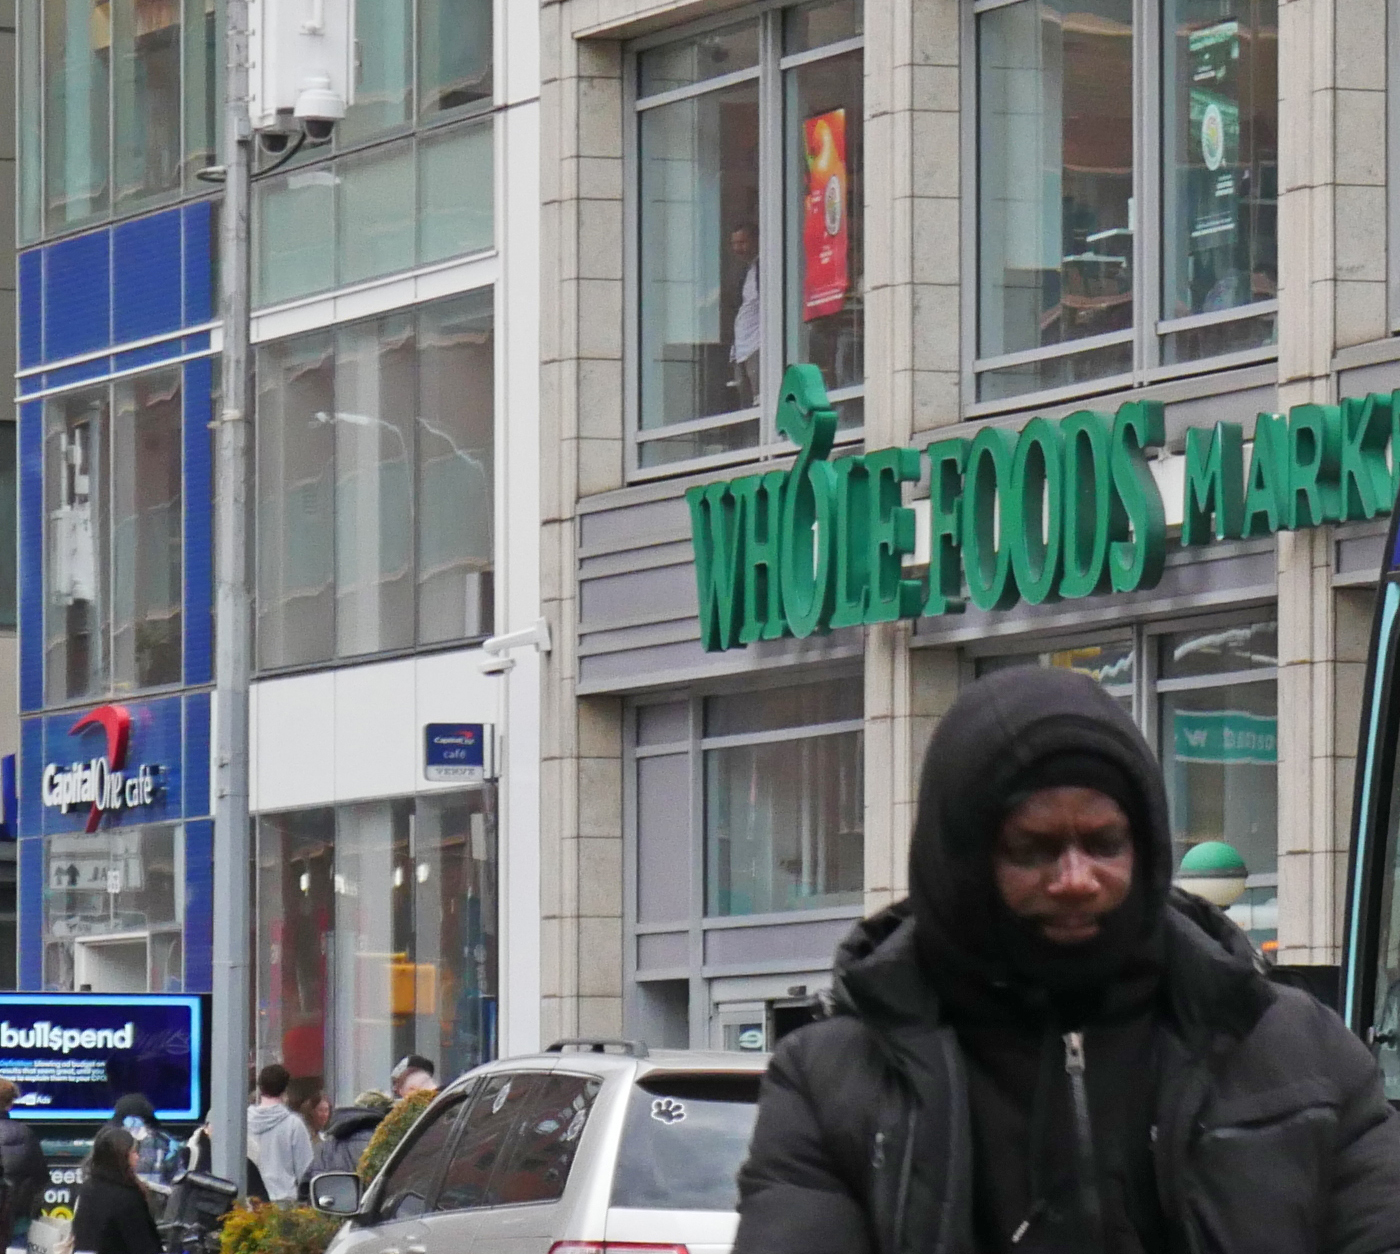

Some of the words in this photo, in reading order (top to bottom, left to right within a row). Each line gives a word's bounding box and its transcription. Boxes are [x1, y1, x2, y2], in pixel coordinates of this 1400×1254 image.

[684, 412, 923, 653] WHOLE
[923, 400, 1166, 618] FOODS
[124, 763, 154, 808] café
[49, 1168, 83, 1184] eet
